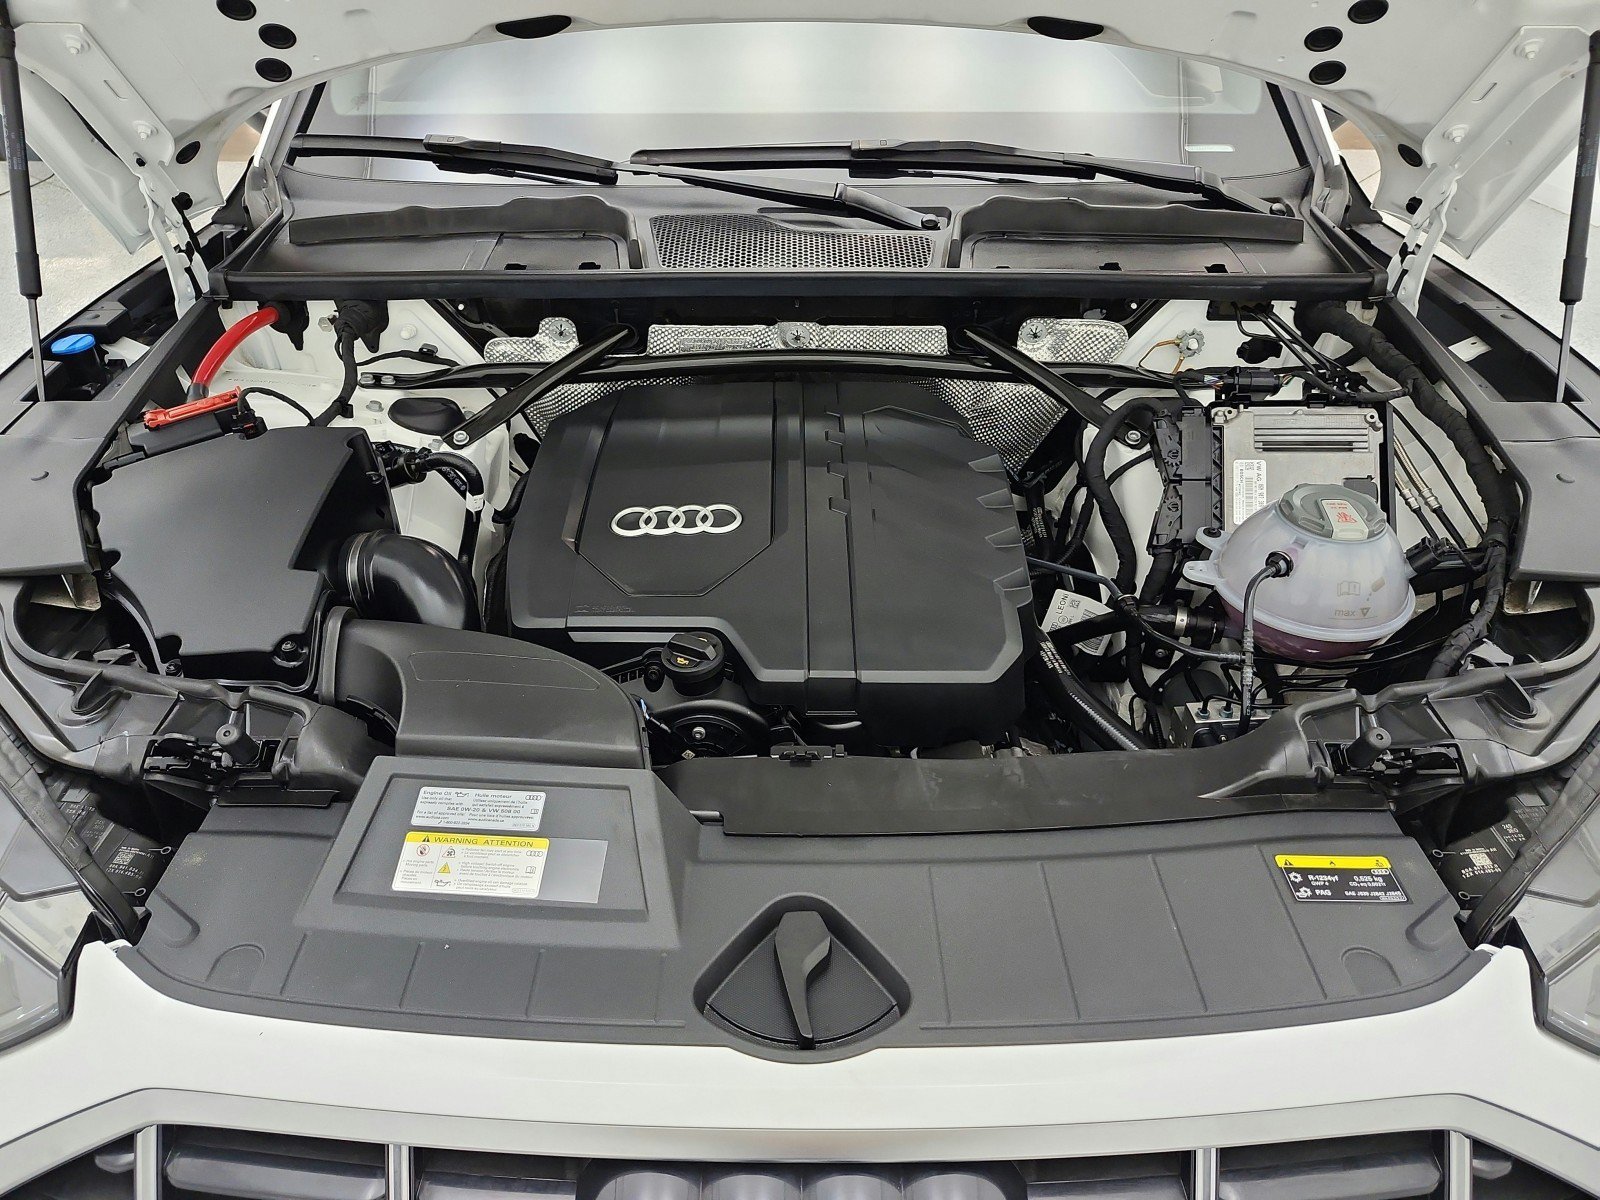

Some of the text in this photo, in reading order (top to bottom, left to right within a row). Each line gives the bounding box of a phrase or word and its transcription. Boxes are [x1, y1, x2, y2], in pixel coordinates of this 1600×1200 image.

[1056, 593, 1069, 615] LEONI
[1334, 609, 1356, 617] max
[434, 837, 534, 848] WARNING ATTENTION
[1307, 874, 1339, 882] R-1234yf
